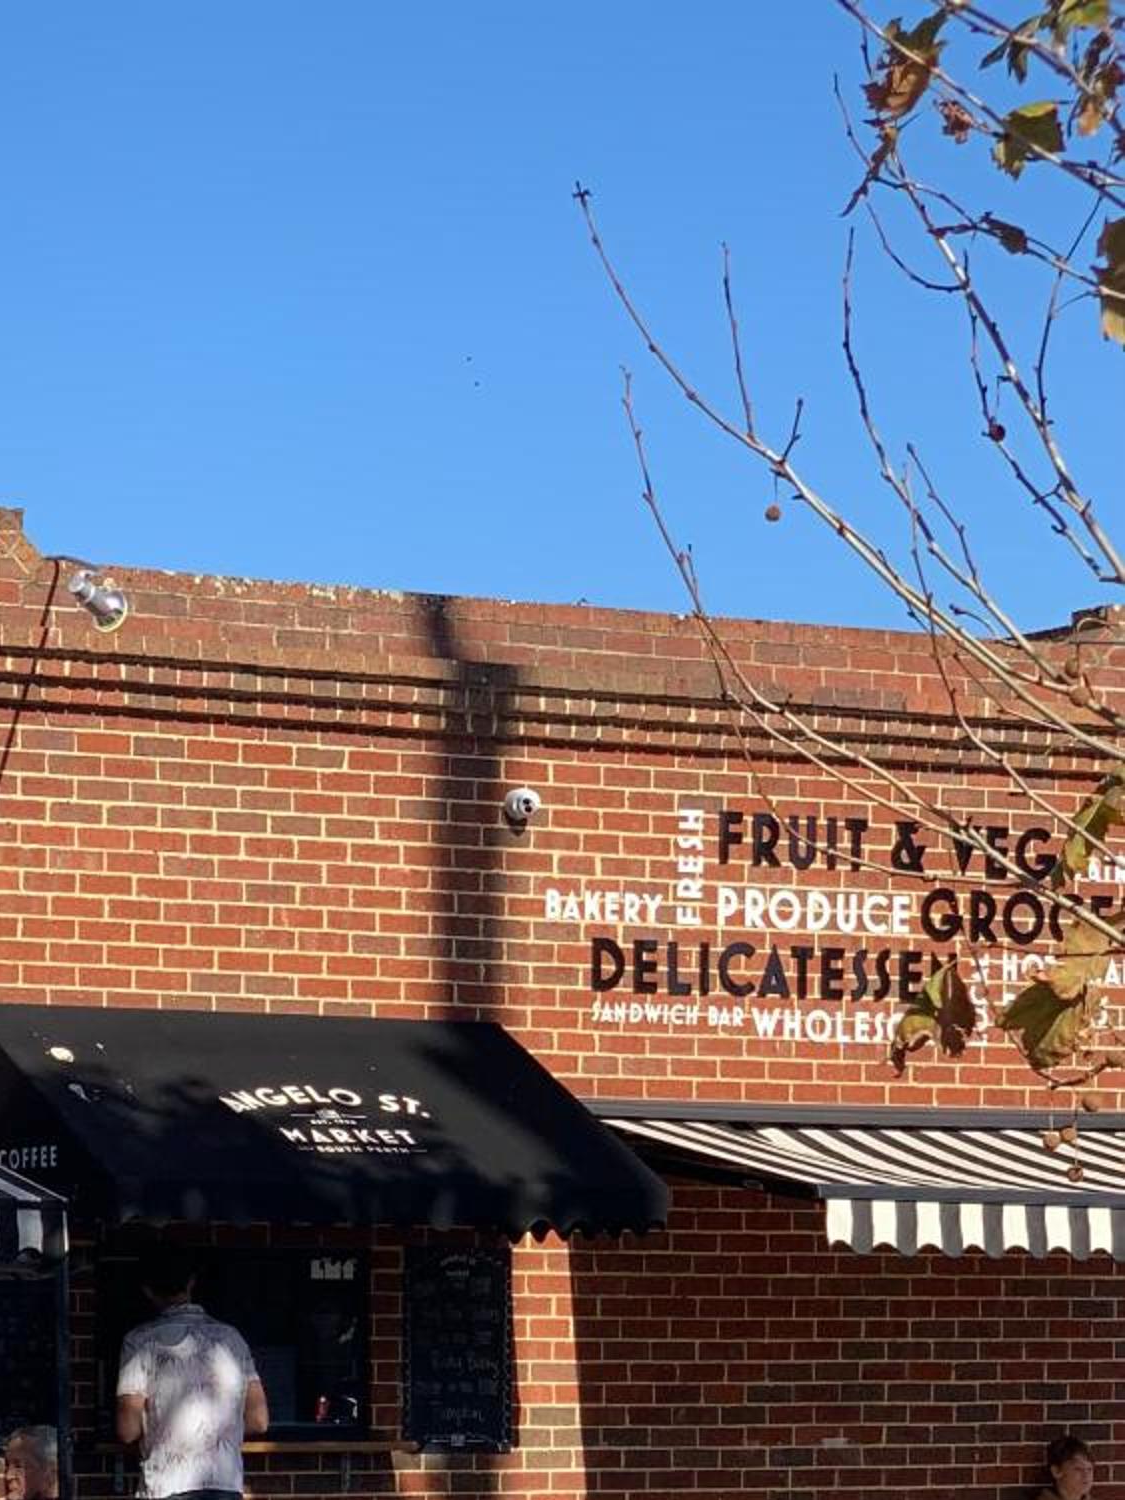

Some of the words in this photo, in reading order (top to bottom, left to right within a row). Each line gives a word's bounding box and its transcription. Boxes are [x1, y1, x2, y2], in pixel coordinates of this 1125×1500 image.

[718, 811, 868, 872] FRUIT
[891, 821, 926, 873] &
[950, 826, 1058, 881] VEG
[677, 809, 704, 926] FRESH
[545, 888, 663, 924] BAKERY
[717, 887, 910, 934] PRODUCE
[591, 1001, 700, 1027] SANDWICH
[707, 1007, 744, 1027] BAR
[218, 1084, 363, 1113] ANGELO
[378, 1094, 431, 1119] ST.
[279, 1126, 416, 1145] MARKET
